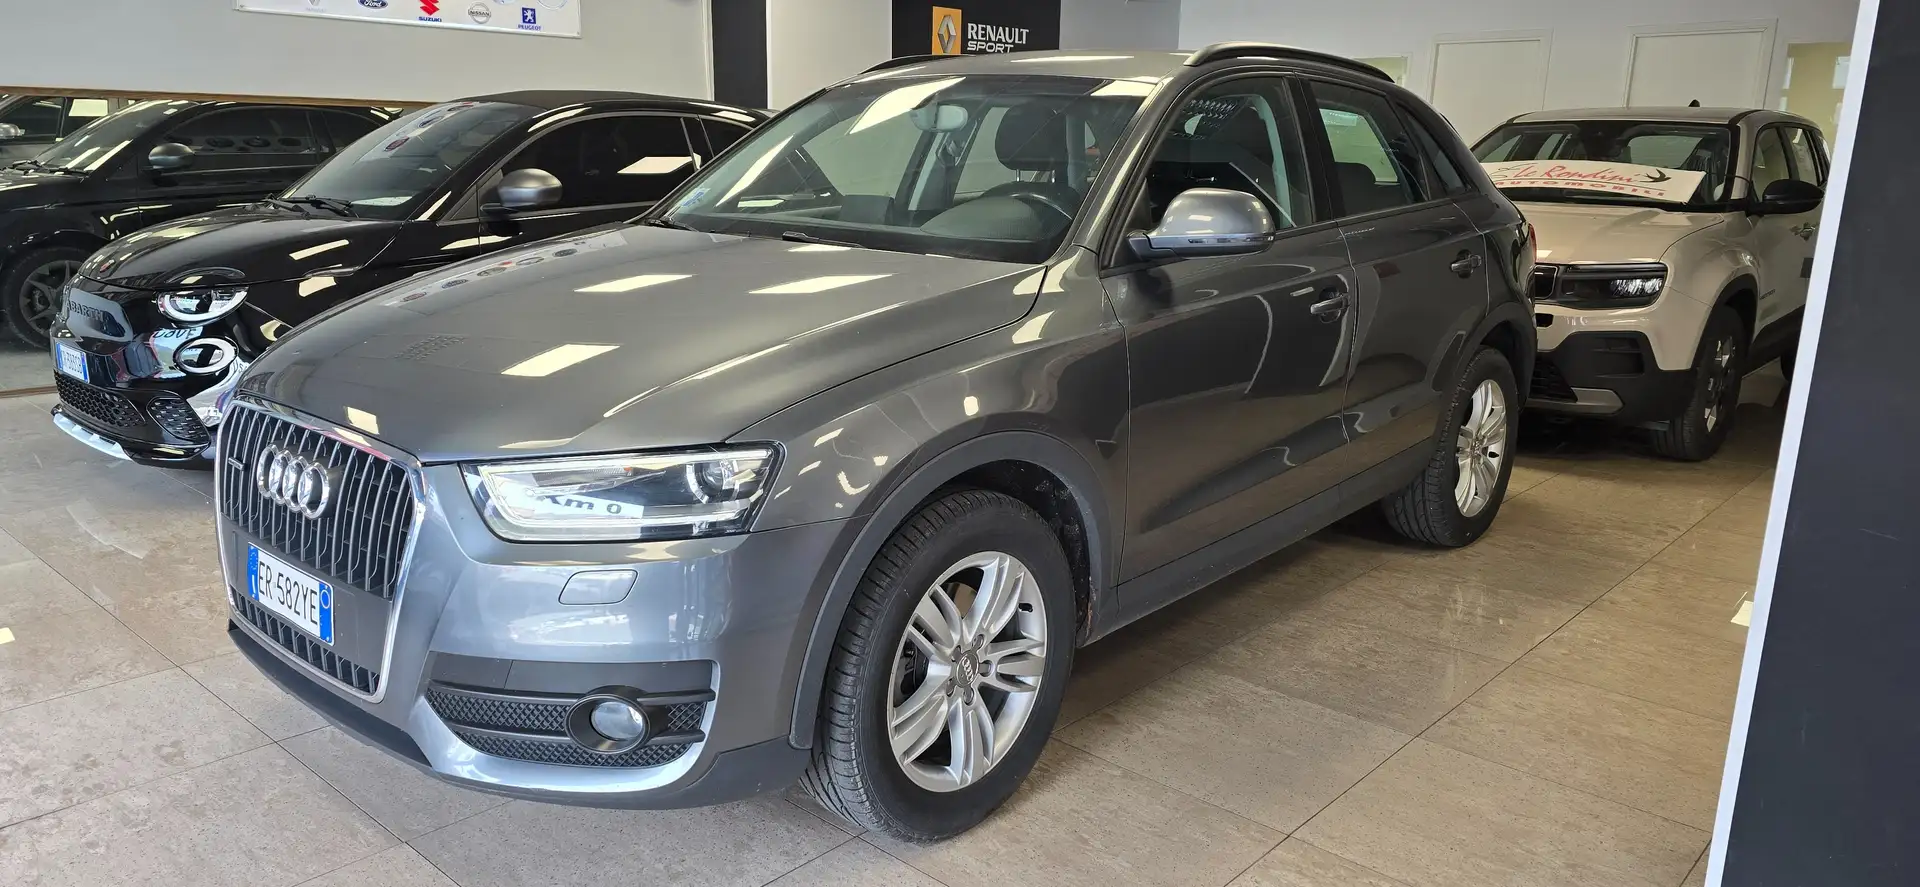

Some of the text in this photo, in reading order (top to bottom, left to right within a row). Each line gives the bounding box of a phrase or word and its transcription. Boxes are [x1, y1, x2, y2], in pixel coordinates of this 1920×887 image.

[967, 23, 1029, 44] RENAULT
[967, 41, 1014, 53] SPORT
[1540, 165, 1641, 183] Rondini
[66, 299, 104, 322] ABARTH
[259, 561, 273, 600] ER
[276, 572, 318, 626] 582YE
